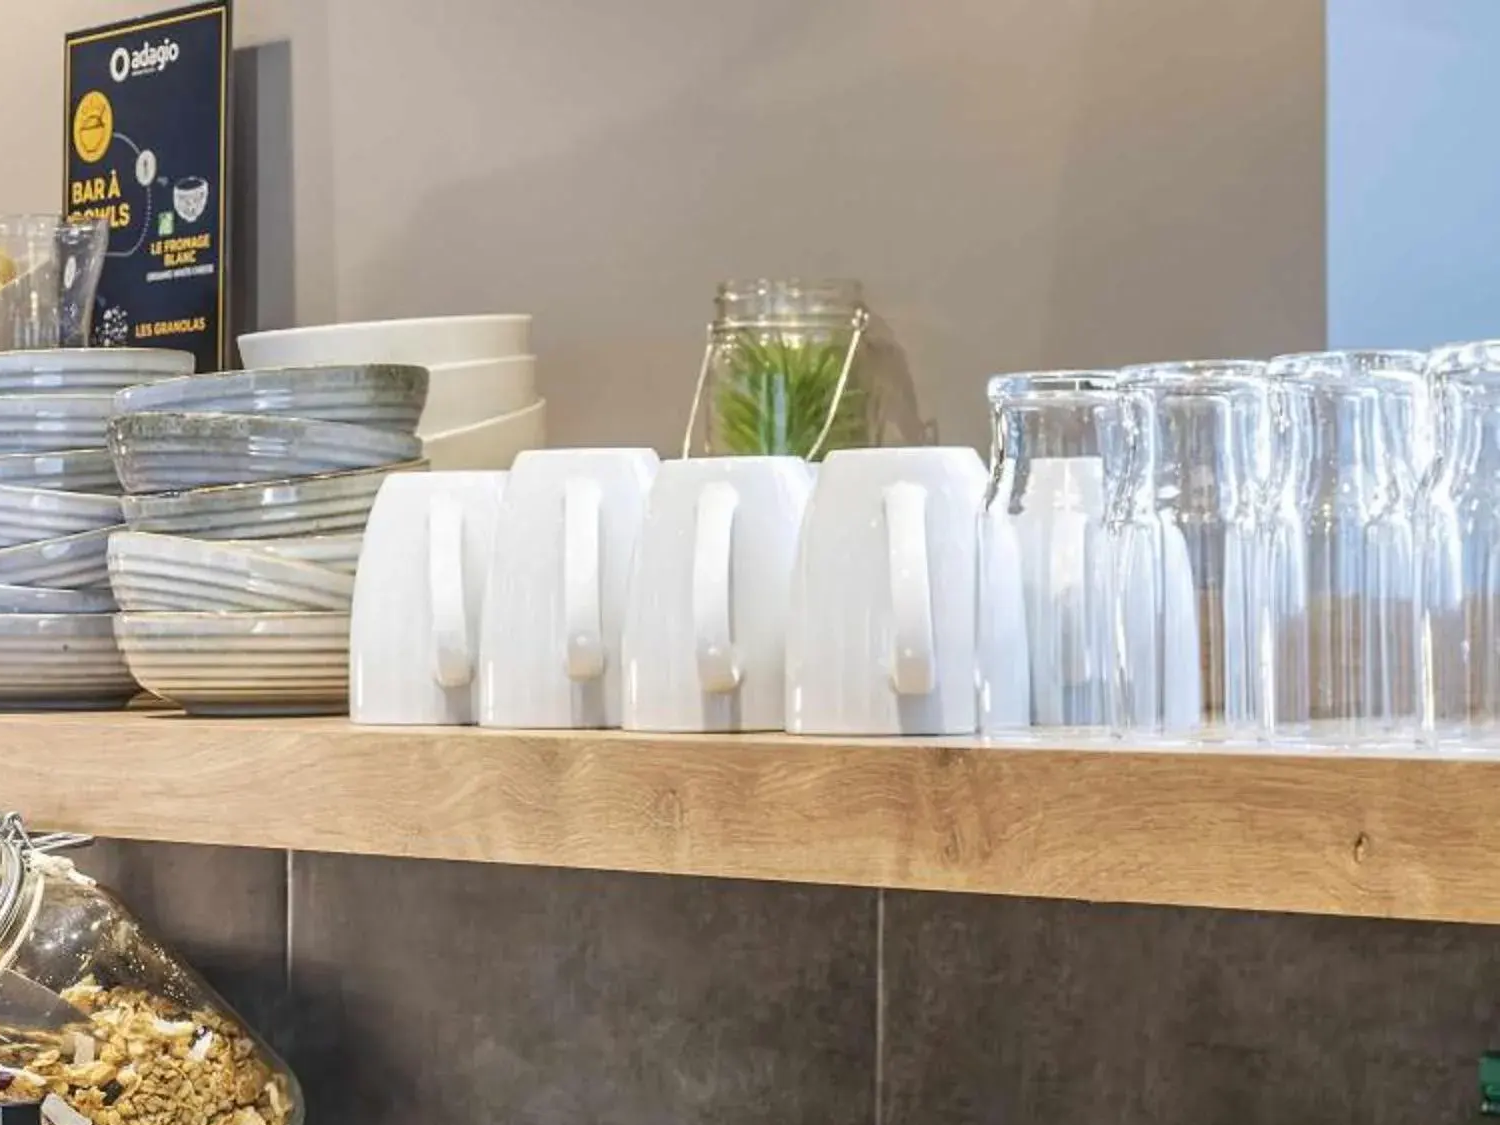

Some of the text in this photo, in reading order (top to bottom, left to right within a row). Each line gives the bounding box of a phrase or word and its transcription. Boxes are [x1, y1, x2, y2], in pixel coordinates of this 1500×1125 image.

[131, 38, 180, 71] adagio
[72, 169, 121, 204] BAR À
[135, 316, 207, 338] LES GRANOLAS
